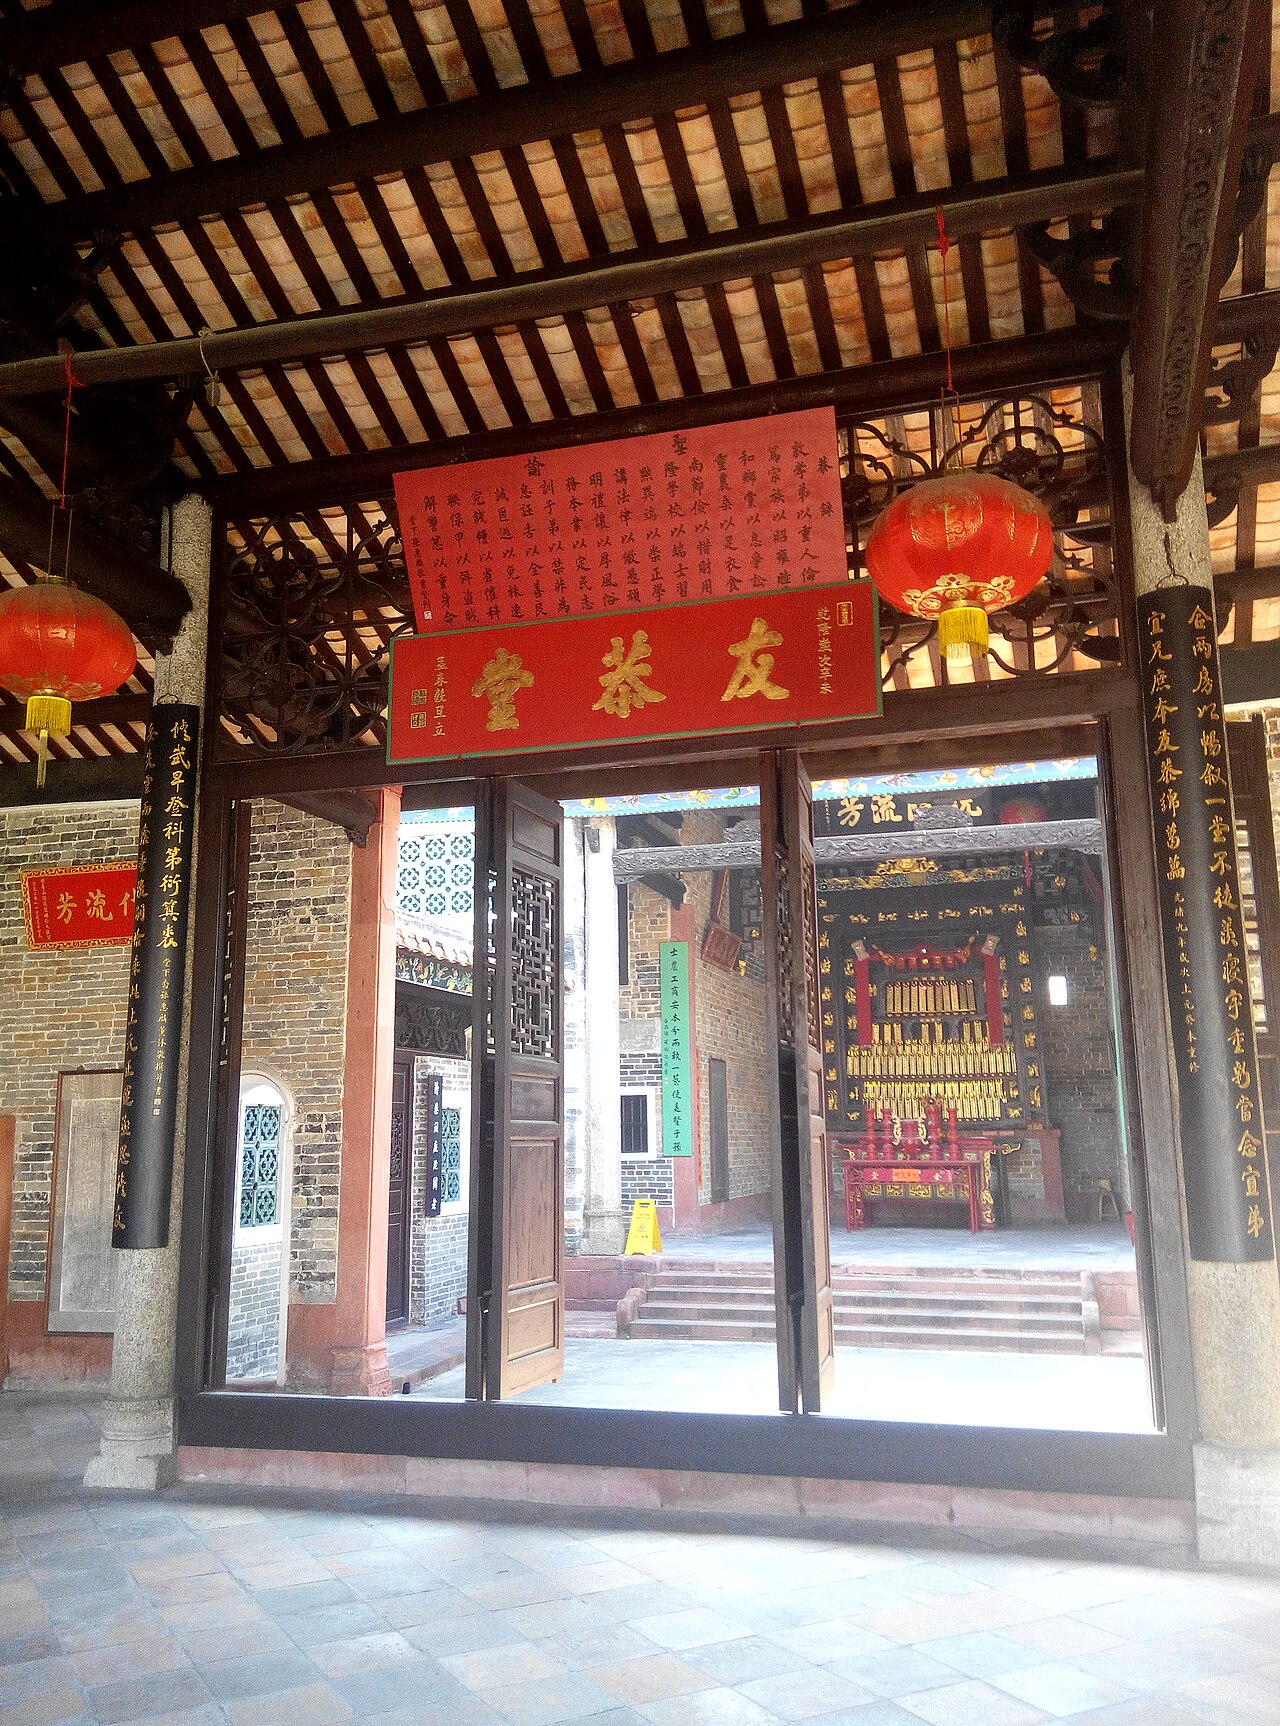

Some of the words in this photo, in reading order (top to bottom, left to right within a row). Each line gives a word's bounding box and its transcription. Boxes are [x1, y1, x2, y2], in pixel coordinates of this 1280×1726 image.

[565, 475, 594, 611] 務本業以定民志
[589, 471, 620, 607] 明禮讓以厚風俗
[663, 460, 689, 598] 隆學校以端士習
[688, 457, 712, 594] 尚節儉以惜財用
[713, 452, 742, 592] 重農桑以足衣食
[471, 617, 791, 732] 友恭堂
